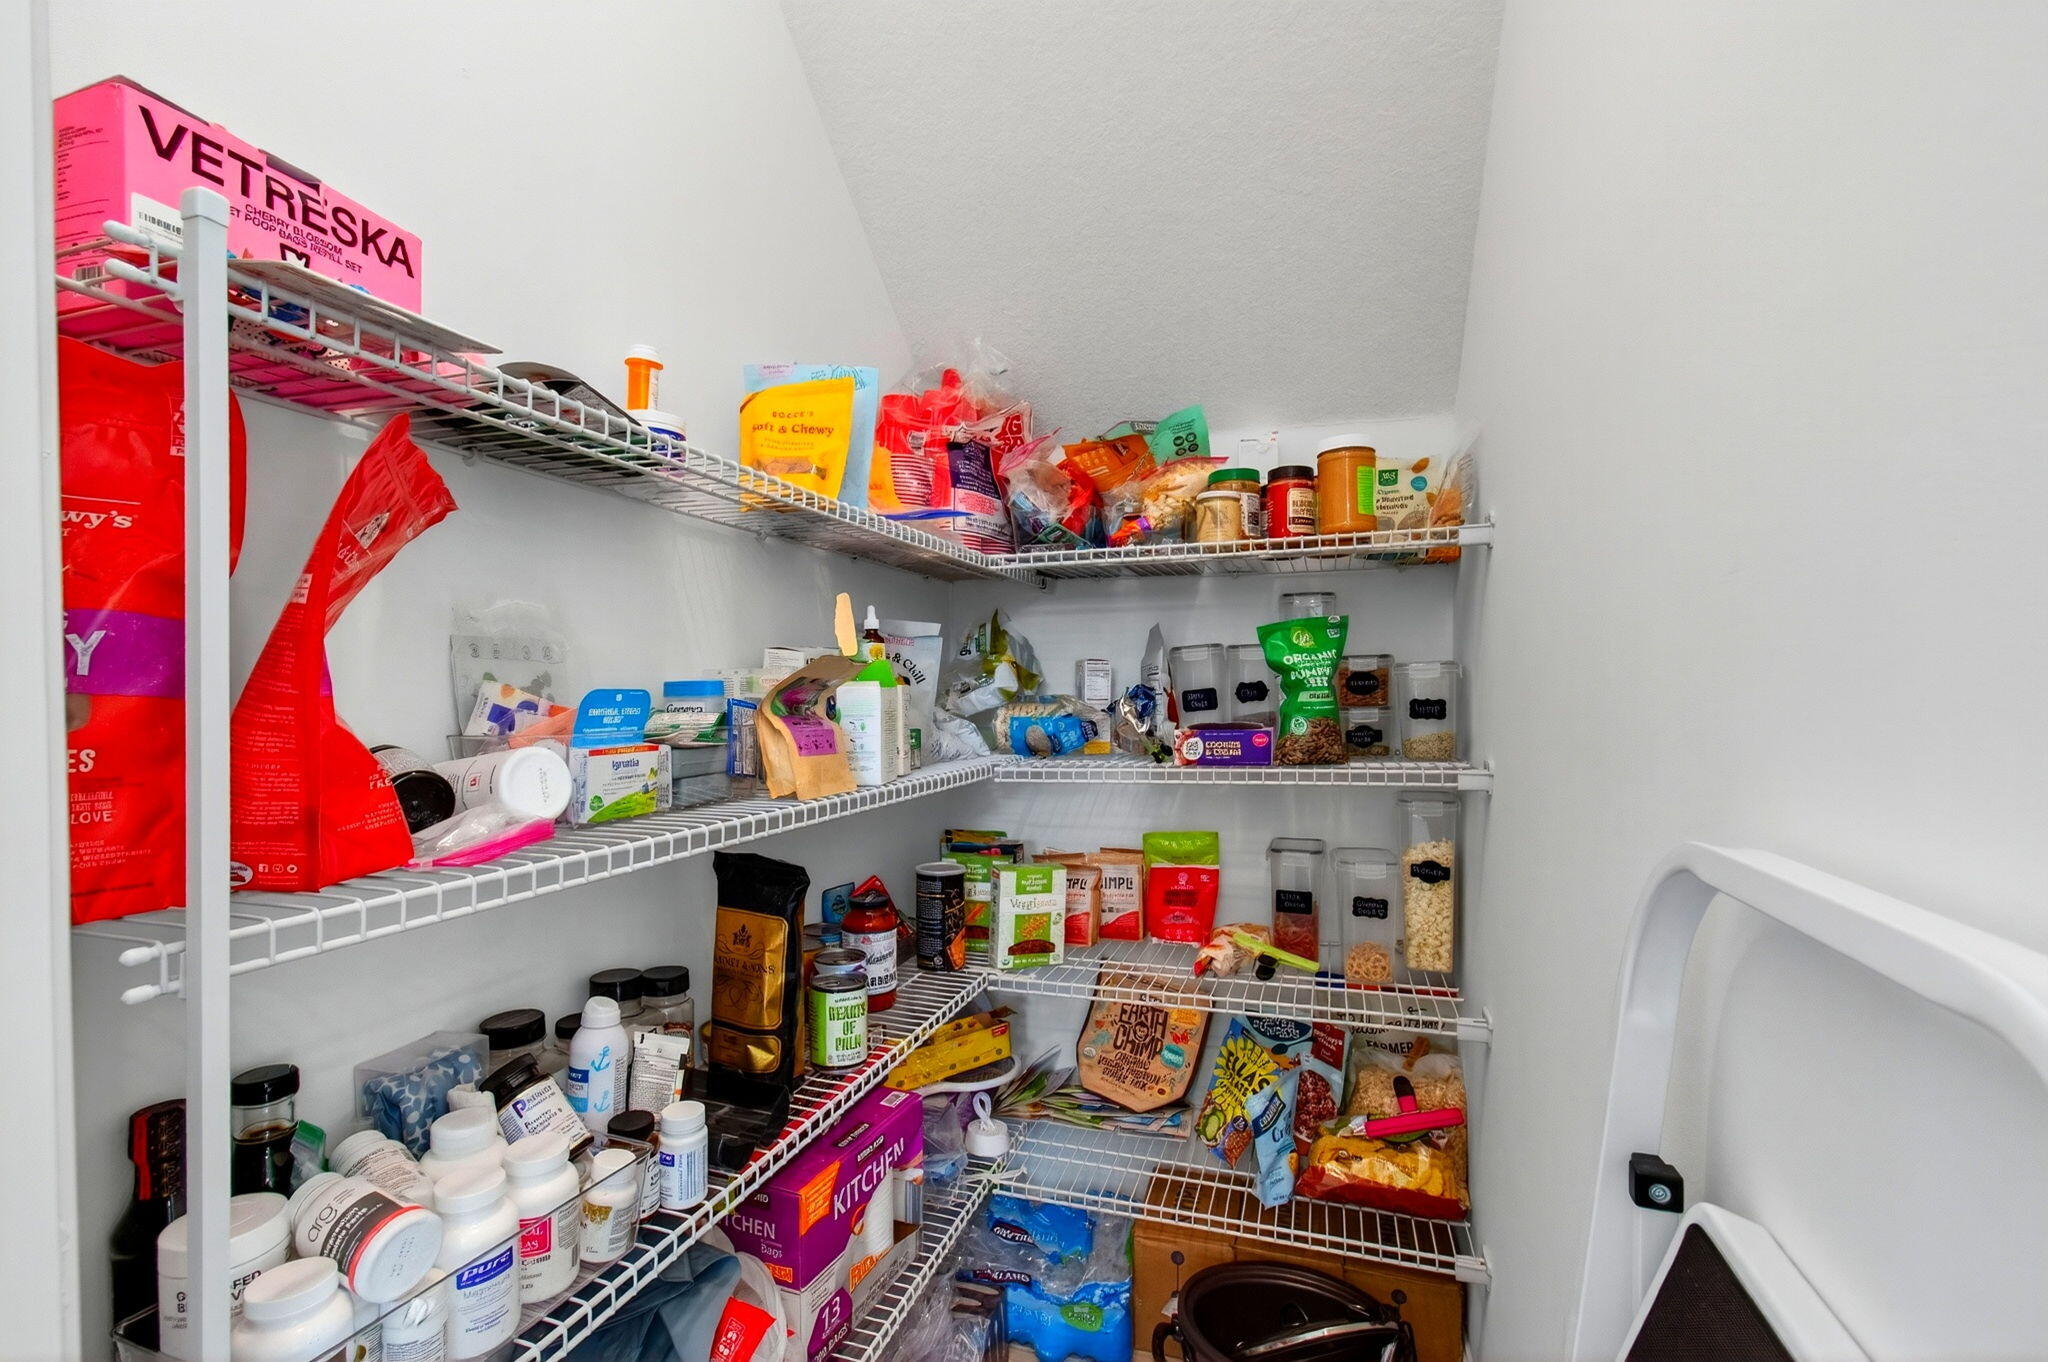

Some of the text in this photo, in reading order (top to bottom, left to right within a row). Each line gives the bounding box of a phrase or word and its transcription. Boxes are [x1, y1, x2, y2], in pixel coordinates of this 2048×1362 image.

[139, 104, 414, 278] VETRESKA
[244, 213, 277, 232] POOP
[278, 228, 308, 249] BAGS
[345, 259, 363, 274] SET
[245, 204, 343, 256] CHERRY BLOSSOM
[791, 423, 835, 438] Chewy
[892, 652, 927, 685] & Chill
[1282, 648, 1338, 666] ORGANIC
[71, 811, 113, 825] LOVE
[828, 1001, 866, 1022] HEARTS
[842, 1020, 857, 1036] OF
[1118, 1003, 1169, 1039] EARTH
[1113, 1023, 1164, 1061] CHIMP
[832, 1137, 905, 1221] KITCHEN
[822, 1296, 841, 1331] 13
